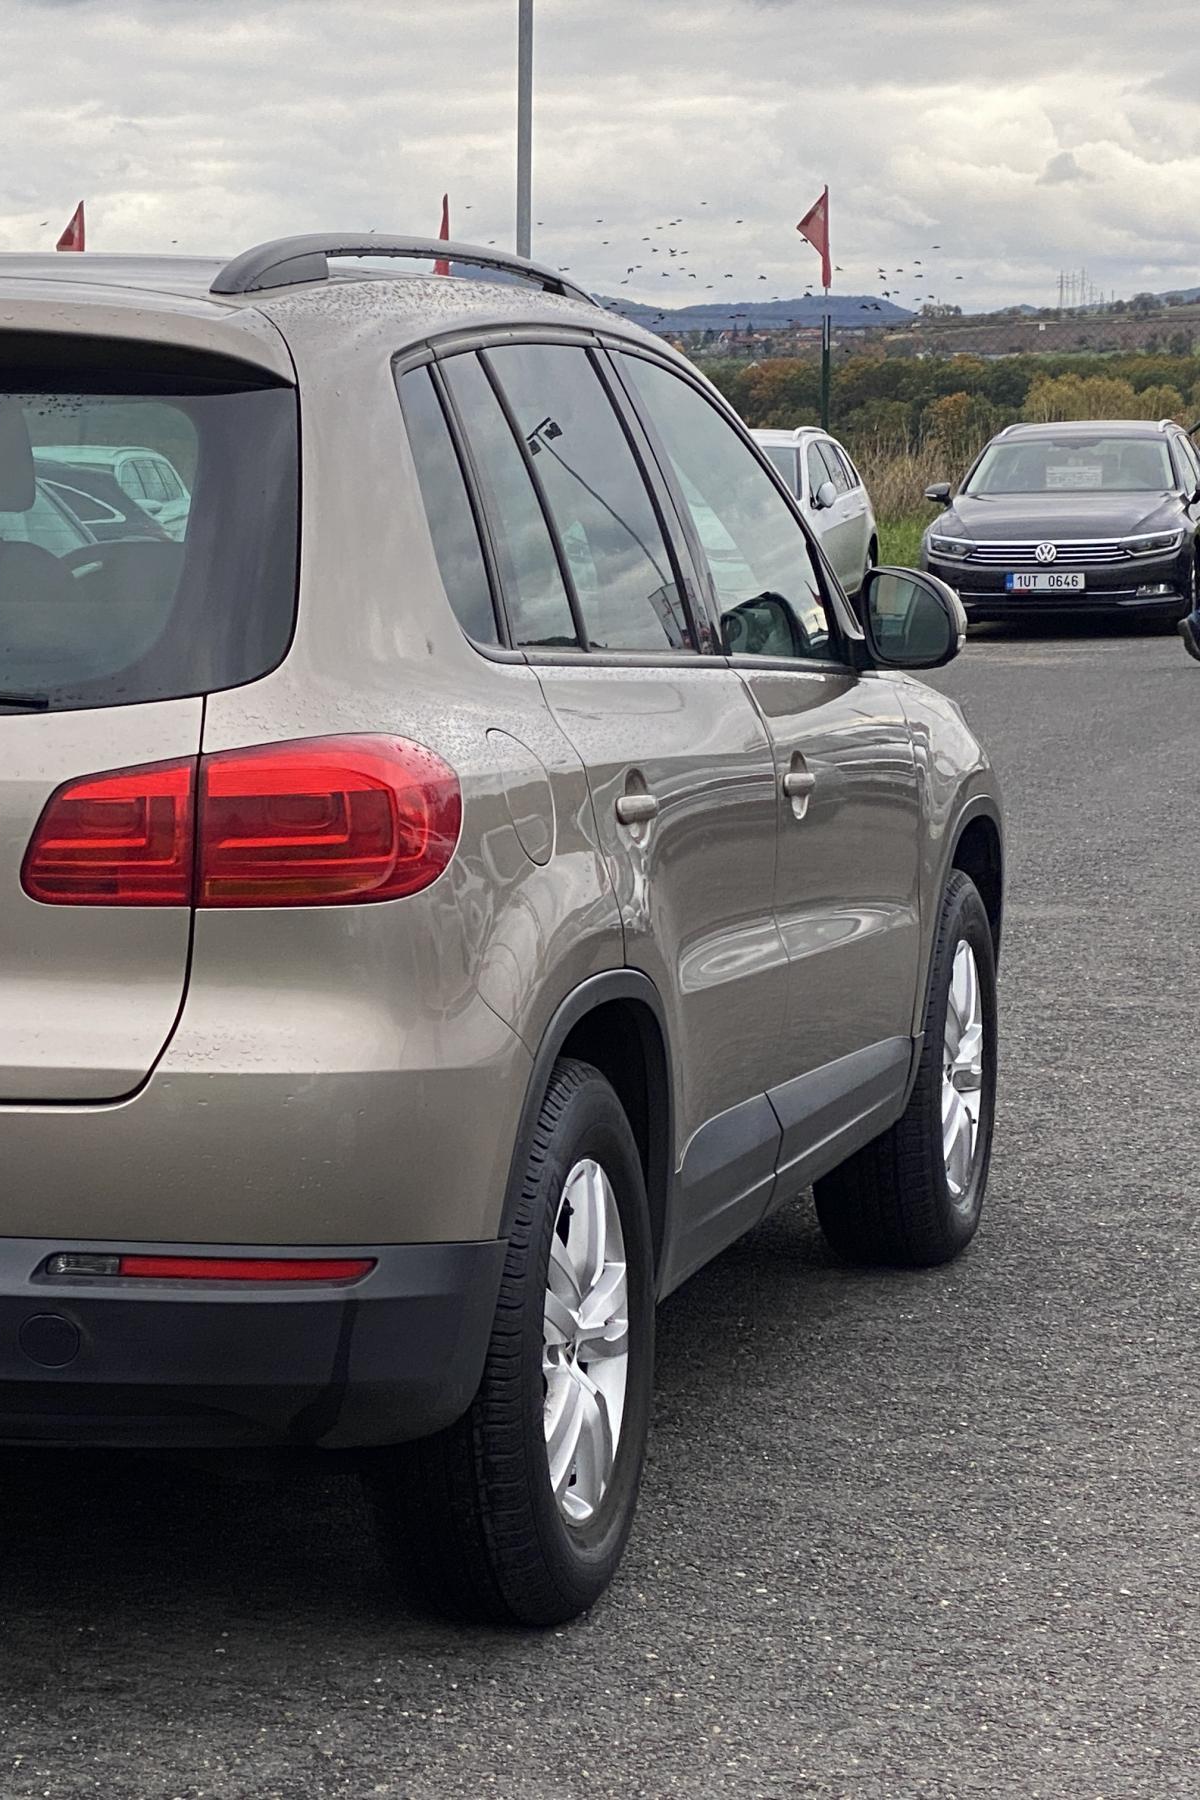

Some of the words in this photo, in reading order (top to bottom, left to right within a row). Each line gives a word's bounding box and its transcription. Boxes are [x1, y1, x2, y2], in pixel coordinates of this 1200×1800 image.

[1036, 543, 1056, 562] VW
[1017, 575, 1039, 588] 1UT
[1048, 575, 1079, 588] 0646
